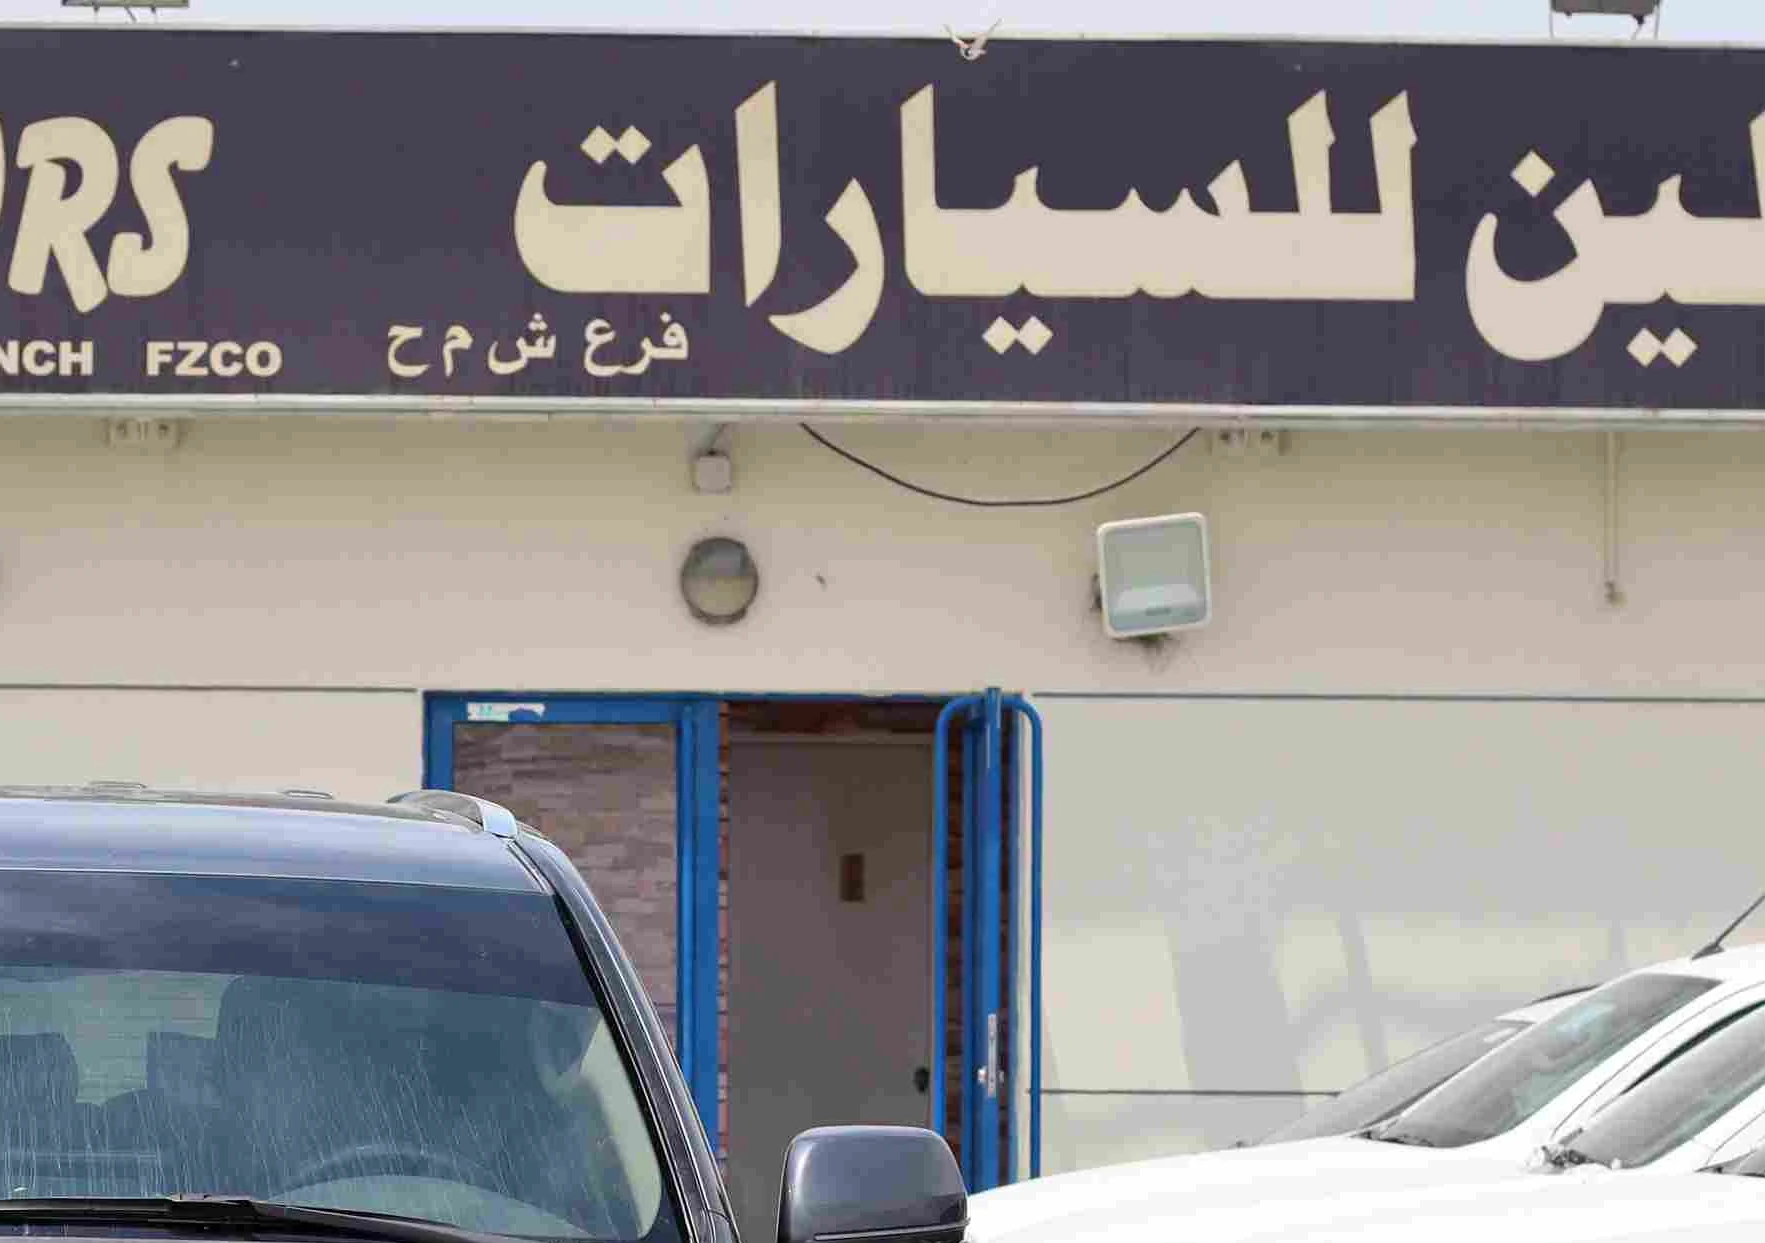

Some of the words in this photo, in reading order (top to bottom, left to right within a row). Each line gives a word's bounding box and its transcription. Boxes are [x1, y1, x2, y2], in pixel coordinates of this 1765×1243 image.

[513, 80, 1418, 356] للسيارات
[145, 340, 284, 378] FZCO
[583, 311, 690, 377] فرع
